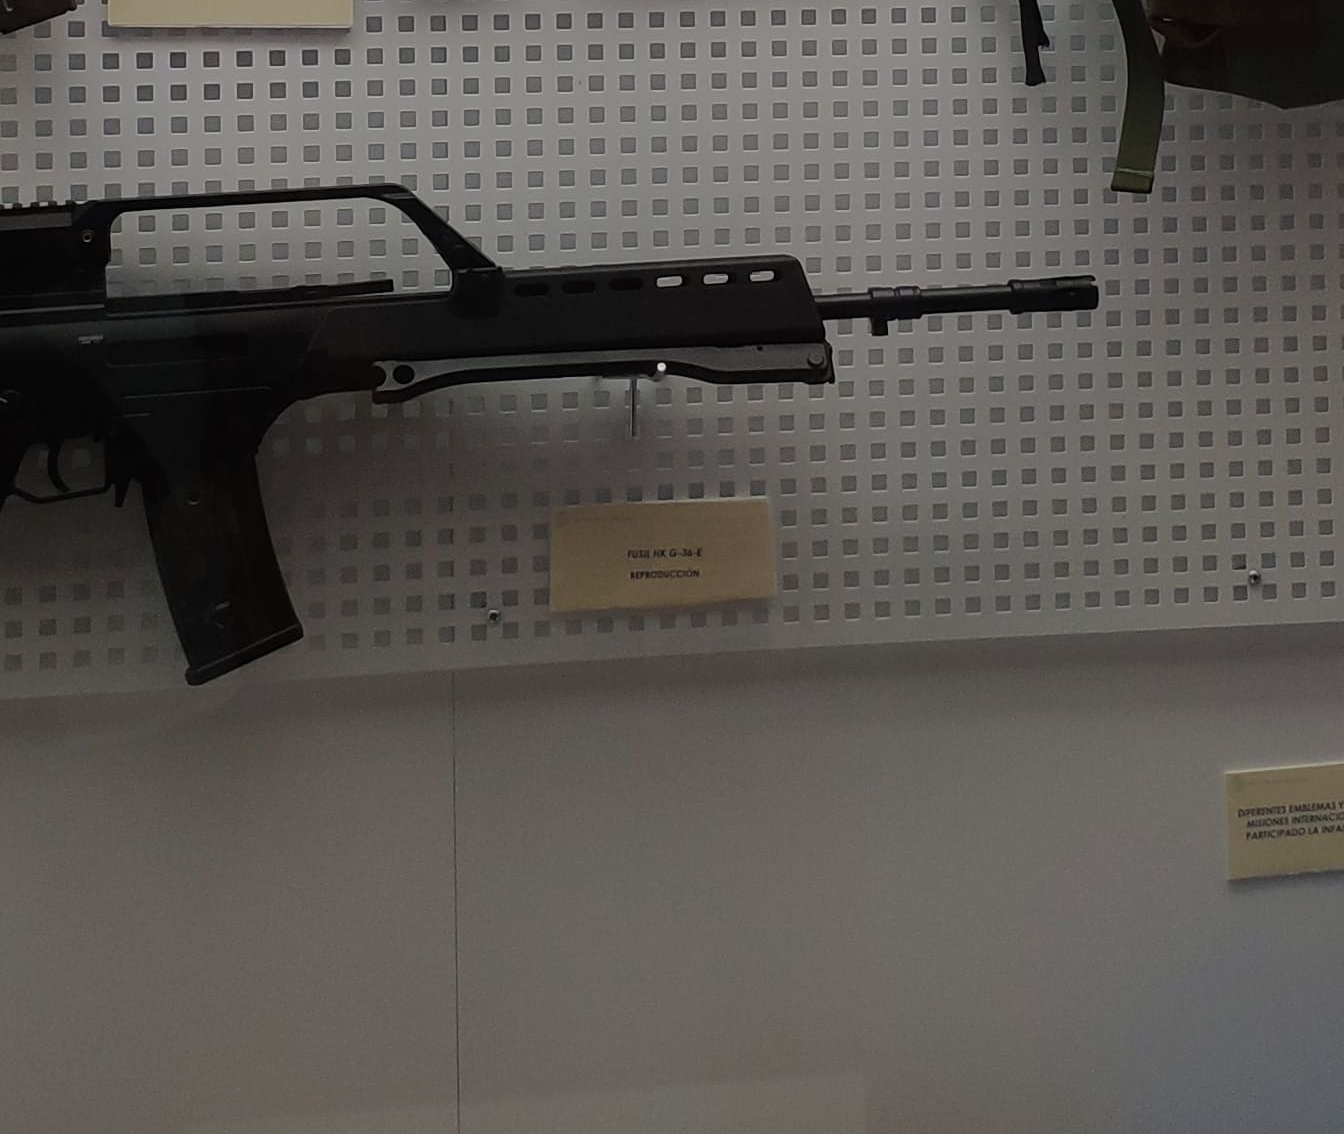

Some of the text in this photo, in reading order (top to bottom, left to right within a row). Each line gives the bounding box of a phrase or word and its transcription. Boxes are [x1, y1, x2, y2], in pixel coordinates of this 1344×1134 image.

[627, 549, 650, 559] FUSIL
[653, 548, 666, 558] HK
[1238, 803, 1286, 818] DIFERENTES
[1288, 800, 1336, 814] EMBLEMAS
[1246, 814, 1289, 828] MISIONES
[1246, 826, 1306, 840] PARTICIPADO
[1307, 825, 1319, 835] LA
